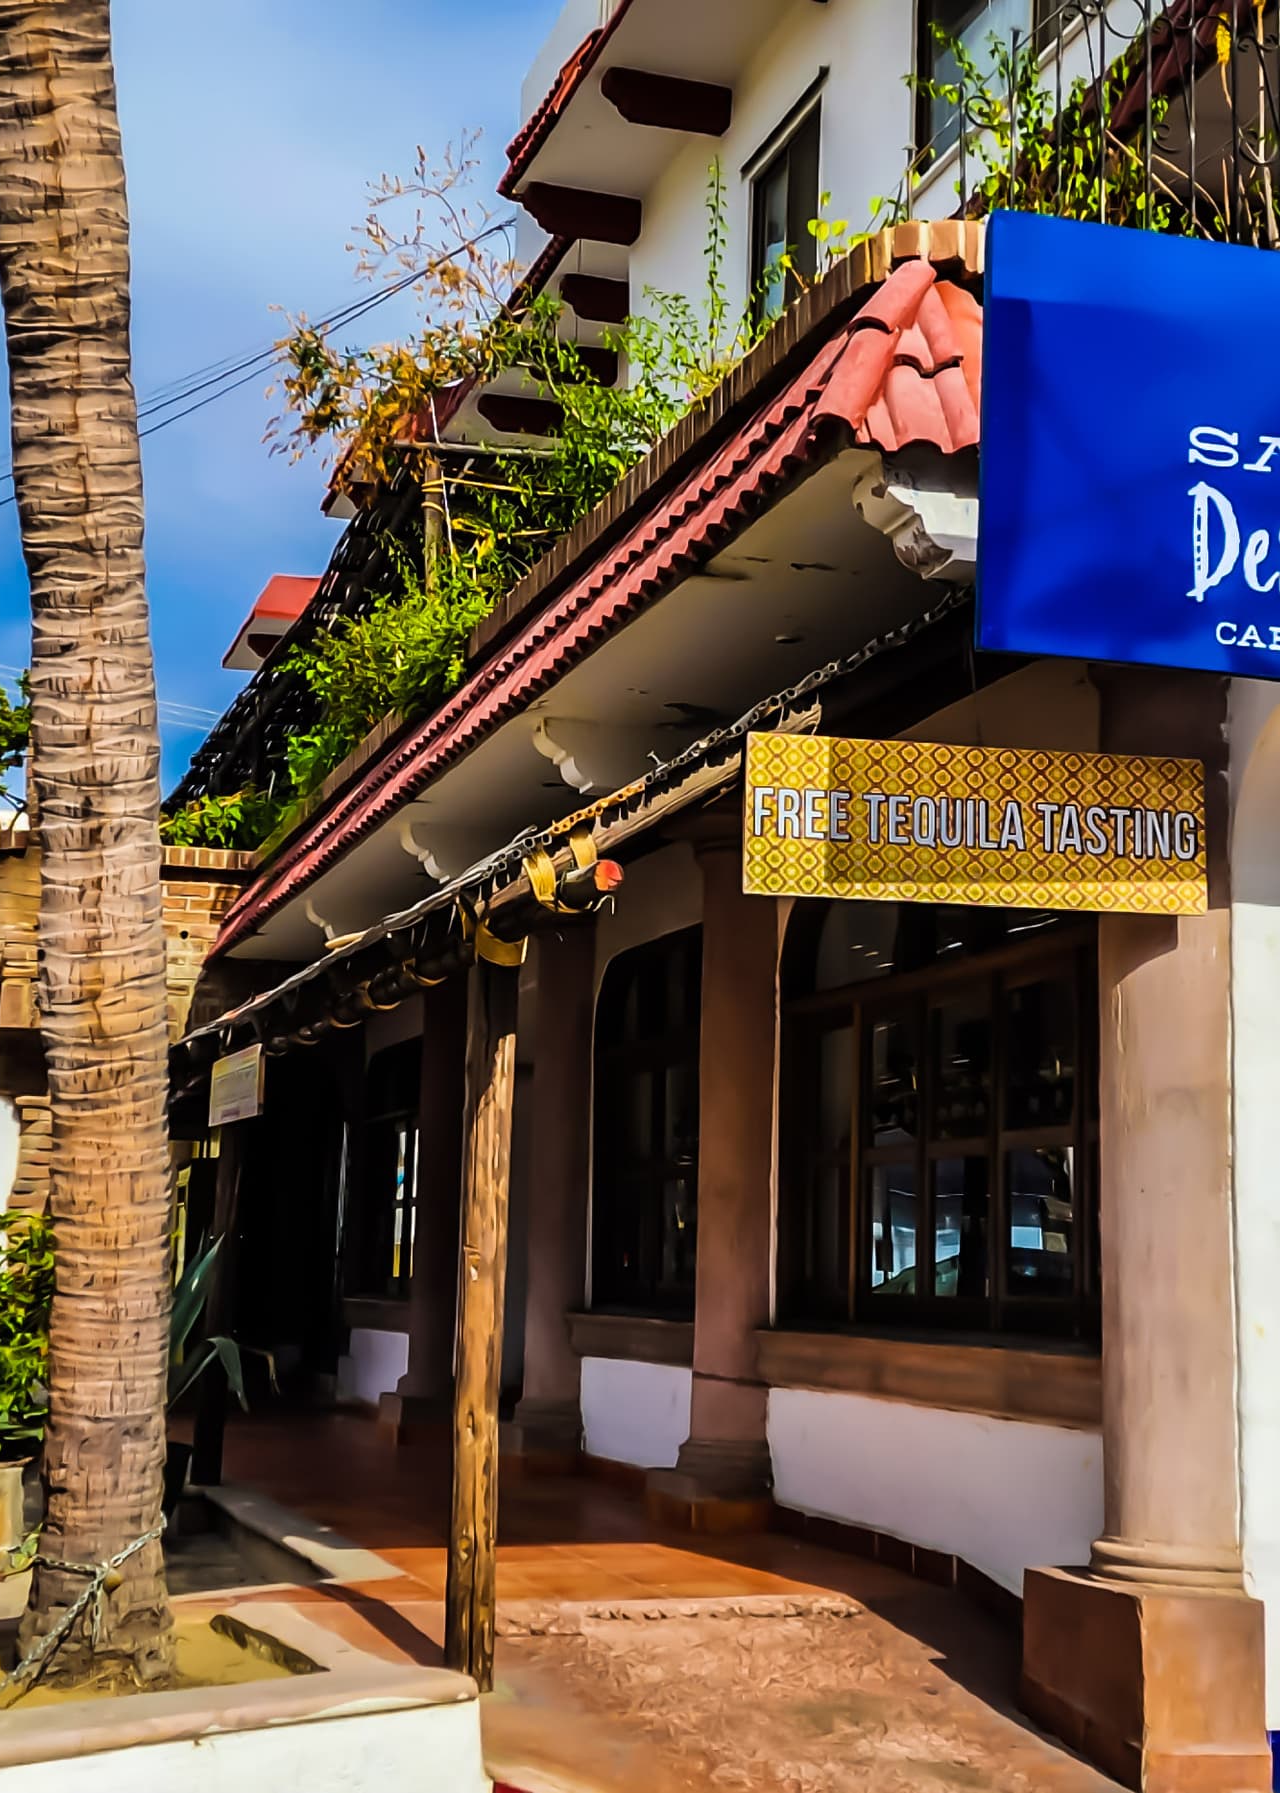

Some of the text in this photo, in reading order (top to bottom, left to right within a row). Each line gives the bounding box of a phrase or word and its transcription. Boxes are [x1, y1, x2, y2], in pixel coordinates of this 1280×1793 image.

[753, 786, 1197, 861] FREE TEQUILA TASTING
